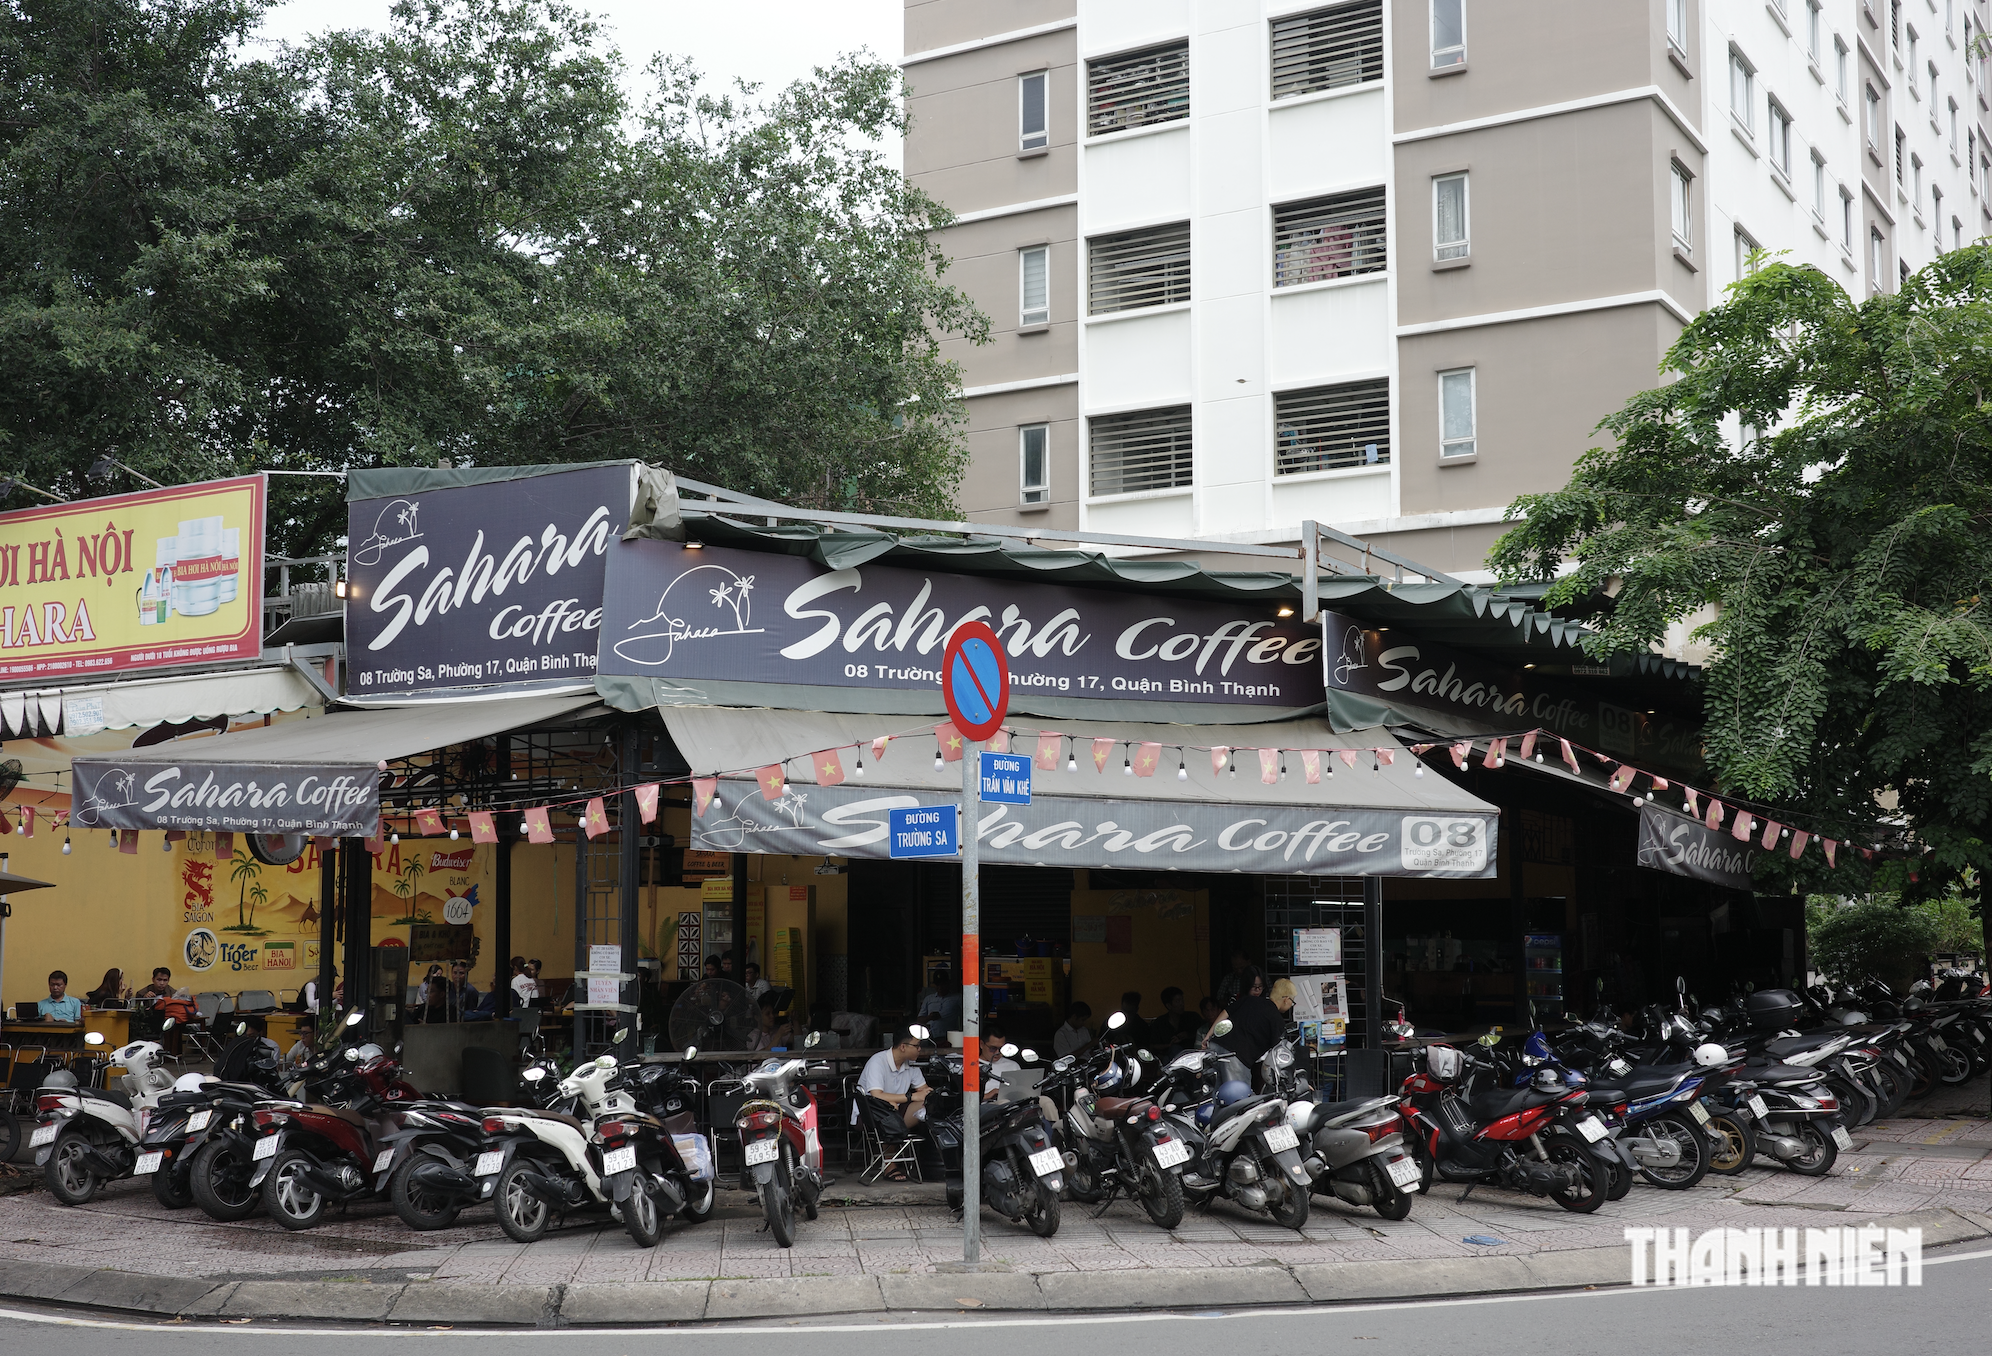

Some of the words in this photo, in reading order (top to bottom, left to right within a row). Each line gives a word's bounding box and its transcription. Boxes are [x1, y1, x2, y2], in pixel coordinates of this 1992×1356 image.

[27, 528, 70, 584] HÀ
[77, 521, 134, 587] NỘI
[177, 564, 188, 576] BIA
[200, 562, 210, 574] HÀ
[368, 505, 619, 650] Sahara
[489, 598, 602, 646] Coffee
[1115, 616, 1323, 677] Coffee
[360, 671, 373, 686] 08
[376, 668, 414, 686] Trường
[417, 665, 435, 682] Sa,
[438, 660, 482, 680] Phường
[485, 661, 502, 677] 17,
[506, 658, 539, 674] Quận
[541, 654, 570, 670] Bình
[844, 664, 868, 679] 08
[1008, 672, 1070, 692] hường
[1077, 675, 1105, 691] 17,
[1111, 676, 1163, 695] Quận
[1170, 677, 1214, 695] Bình
[1220, 681, 1281, 699] Thạnh
[1376, 645, 1530, 718] Sahara
[1532, 692, 1590, 732] Coffee
[1602, 707, 1631, 734] 08
[993, 758, 1020, 773] ĐƯỜNG
[141, 767, 294, 813] Sahara
[296, 776, 370, 814] Coffee
[982, 773, 1000, 795] TRẦN
[1000, 774, 1015, 796] VĂN
[1016, 776, 1030, 797] KHÊ
[156, 816, 168, 824] 08
[170, 816, 204, 828] Trường
[206, 817, 221, 828] Sa,
[222, 816, 259, 828] Phường
[262, 818, 276, 828] 17,
[277, 819, 303, 830] Quận
[306, 819, 329, 830] Bình
[331, 820, 364, 831] Thạnh
[905, 810, 940, 825] ĐƯỜNG
[817, 796, 1207, 853] Shara
[1218, 818, 1389, 862] Coffee
[1410, 821, 1477, 848] 08
[896, 828, 932, 848] TRƯỜNG
[934, 830, 948, 846] SA
[1404, 846, 1431, 859] Trường
[1432, 849, 1444, 858] Sa,
[1446, 848, 1472, 860] Phường
[1474, 850, 1482, 858] 17
[1666, 827, 1744, 874] Sahara
[430, 853, 472, 868] Budweiser
[1414, 858, 1432, 868] Quận
[1434, 858, 1450, 867] Bình
[450, 876, 470, 886] BLANC
[192, 902, 204, 912] BIA
[447, 901, 470, 918] 1664
[1108, 890, 1180, 916] Sahara
[184, 912, 214, 922] SAIGON
[419, 930, 429, 939] BIA
[1534, 938, 1556, 946] pepsi
[220, 943, 258, 971] Tiger
[271, 950, 284, 958] BIA
[266, 958, 292, 968] HANOI
[608, 1149, 630, 1163] 59-D2
[750, 1142, 772, 1154] 59-S1
[1160, 1142, 1180, 1155] 43-AB
[748, 1150, 776, 1163] 549.56
[1034, 1150, 1056, 1163] 72-AH
[1162, 1150, 1186, 1167] 320.16
[606, 1158, 634, 1174] 941.23
[1036, 1158, 1063, 1174] 111.13
